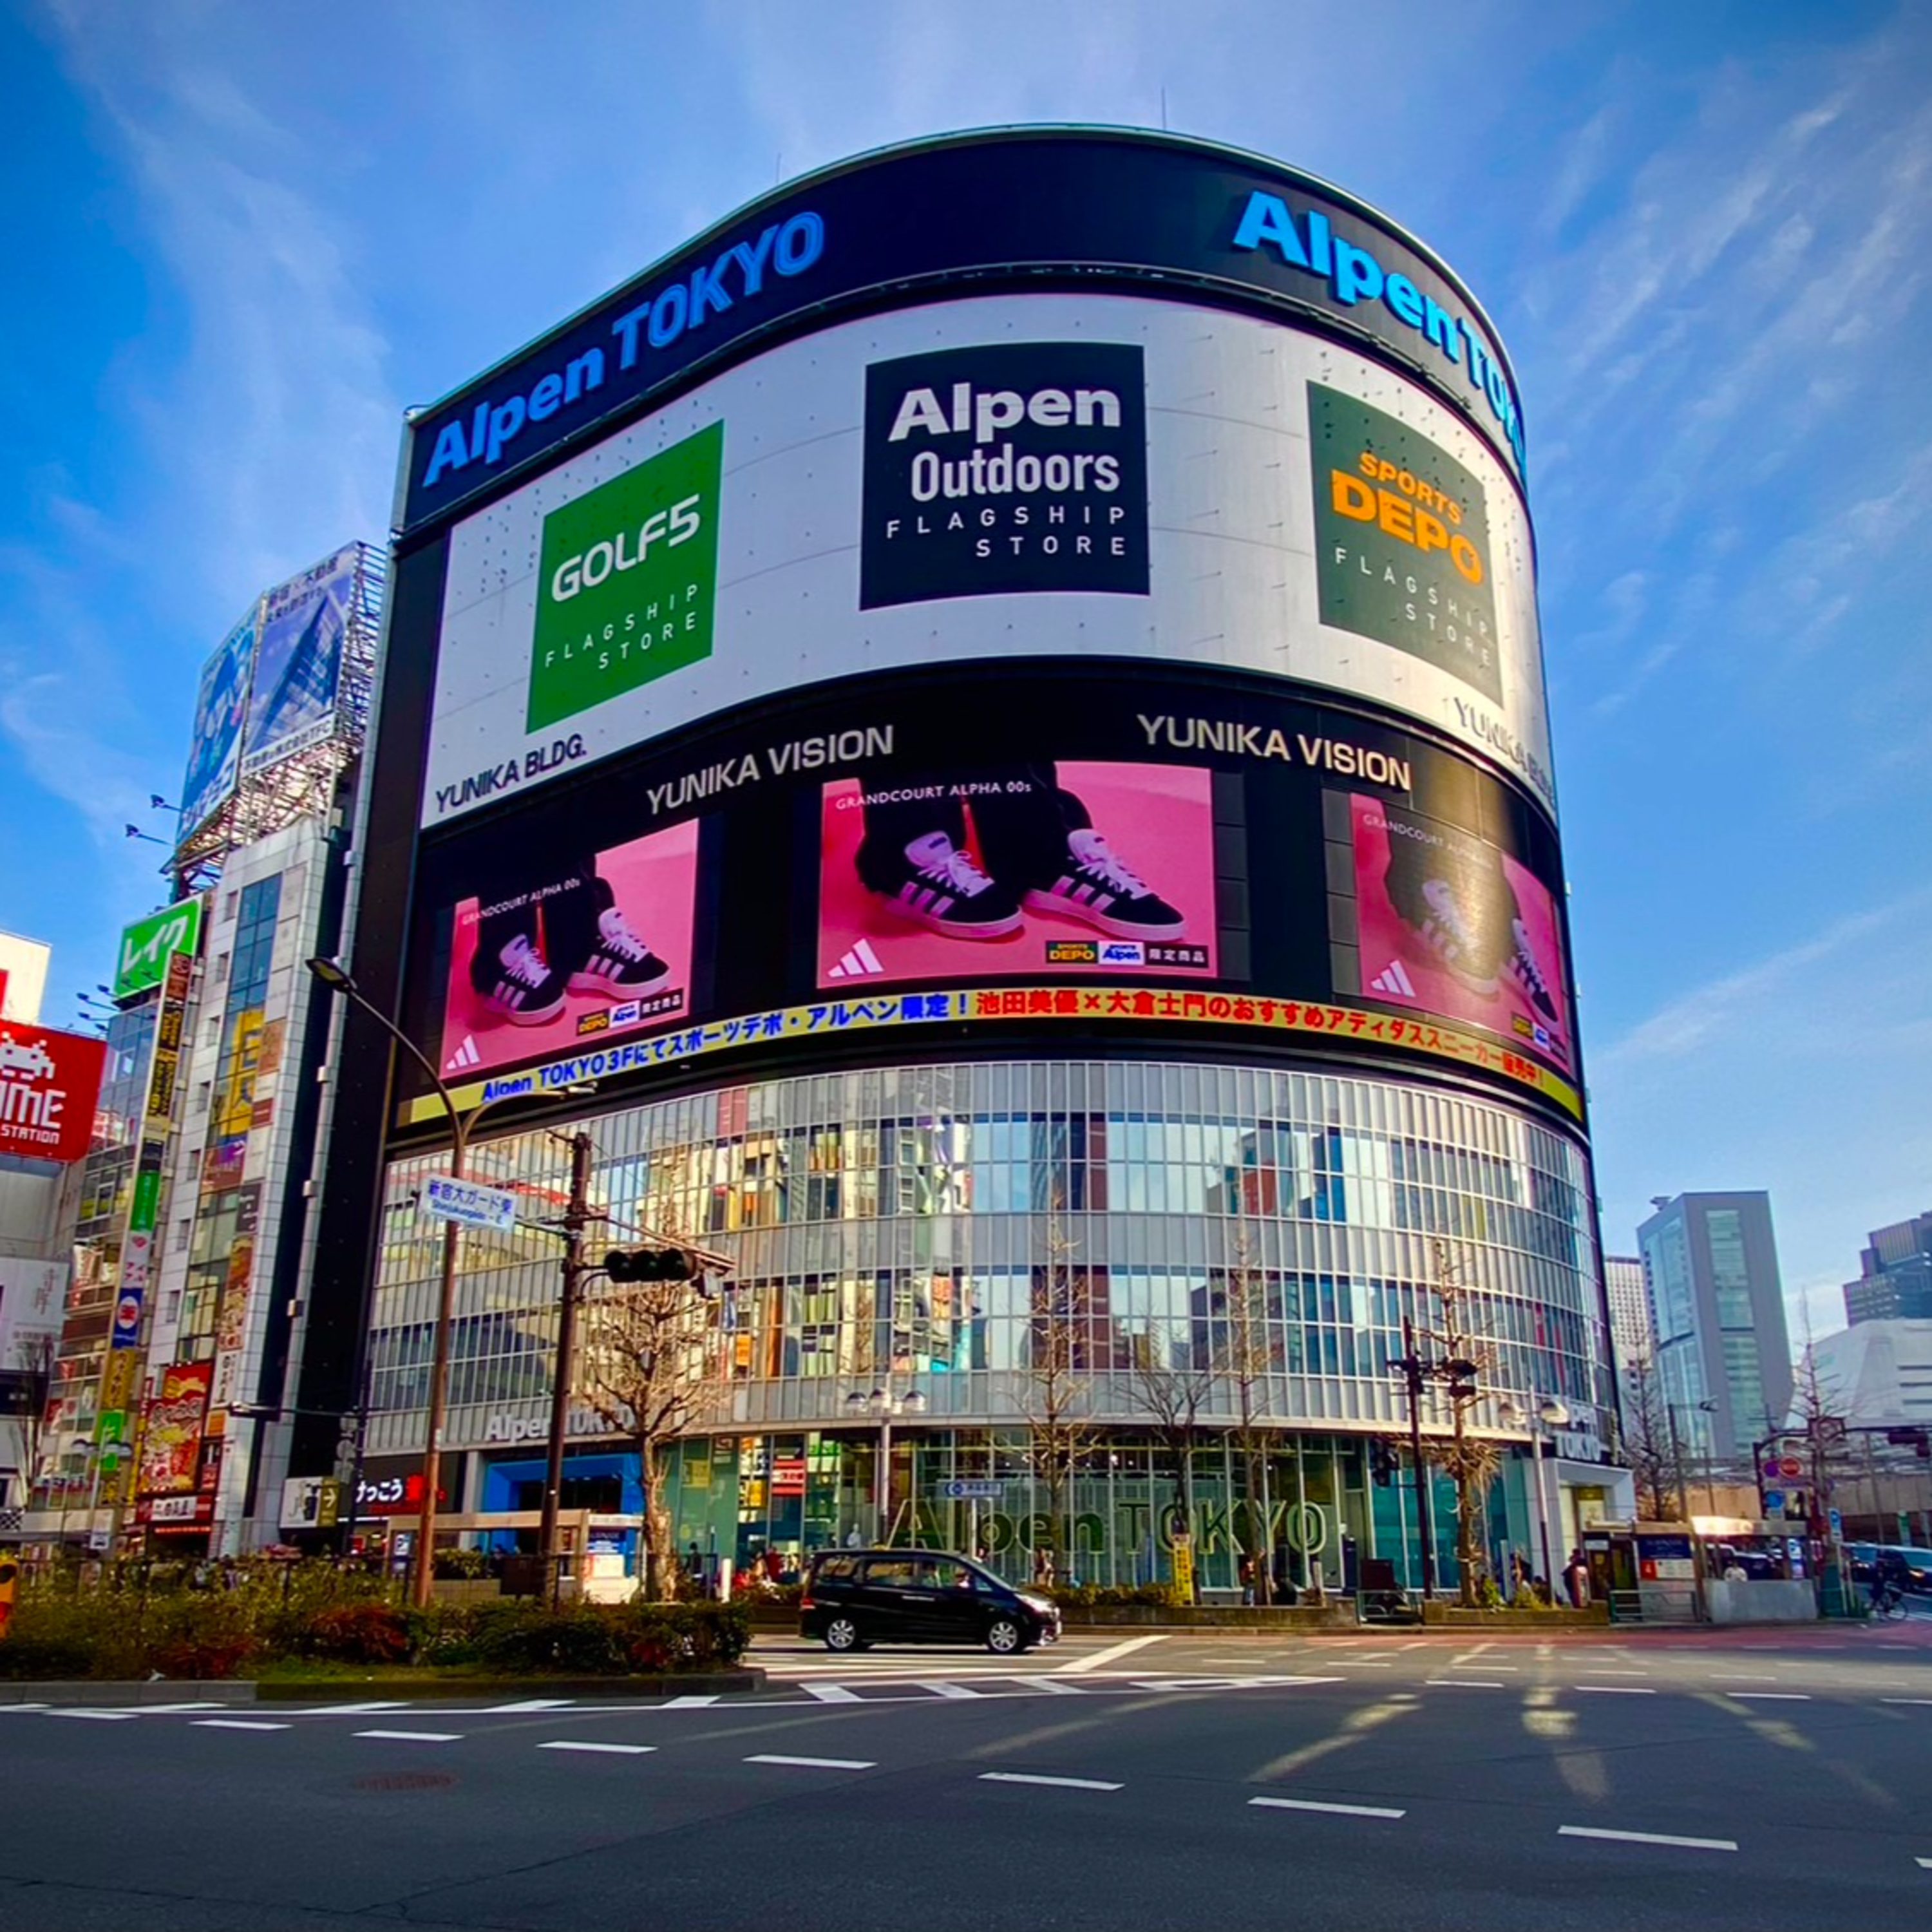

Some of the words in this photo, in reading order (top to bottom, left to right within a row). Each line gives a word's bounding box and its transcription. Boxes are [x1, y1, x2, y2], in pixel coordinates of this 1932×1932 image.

[1232, 191, 1460, 365] Alpen
[422, 346, 605, 488] Alpen
[612, 211, 824, 370] TOKYO
[888, 382, 1121, 443] Alpen
[911, 443, 1120, 502] Outdoors
[1359, 452, 1462, 526] SPORTS
[551, 494, 700, 601] GOLF5
[886, 506, 1124, 539] FLAGSHIP
[976, 536, 1124, 557] STORE
[1331, 469, 1482, 584] DEPO
[1335, 547, 1488, 634] FLAGSHIP
[545, 584, 698, 668] FLAGSHIP
[598, 612, 697, 670] STORE
[1405, 603, 1490, 667] STORE
[1136, 713, 1291, 761] YUNIKA
[1297, 733, 1411, 791] VISION
[1454, 697, 1528, 772] YUNIKA
[435, 759, 519, 813] YUNIKA
[524, 734, 587, 779] BLDG.
[646, 753, 761, 814] YUNIKA
[767, 725, 894, 775] VISION
[836, 786, 944, 810] GRANDCOURT
[949, 782, 1001, 796] ALPHA
[1007, 781, 1031, 792] 00s
[1363, 815, 1443, 846] GRANDCOURT
[462, 893, 527, 925] GRANDCOURT
[529, 884, 562, 902] ALPHA
[122, 915, 188, 973] レイク
[1049, 949, 1095, 961] DEPO
[1103, 948, 1141, 961] Alpen
[0, 1124, 60, 1144] STATION
[1115, 1499, 1327, 1555] TOKYO
